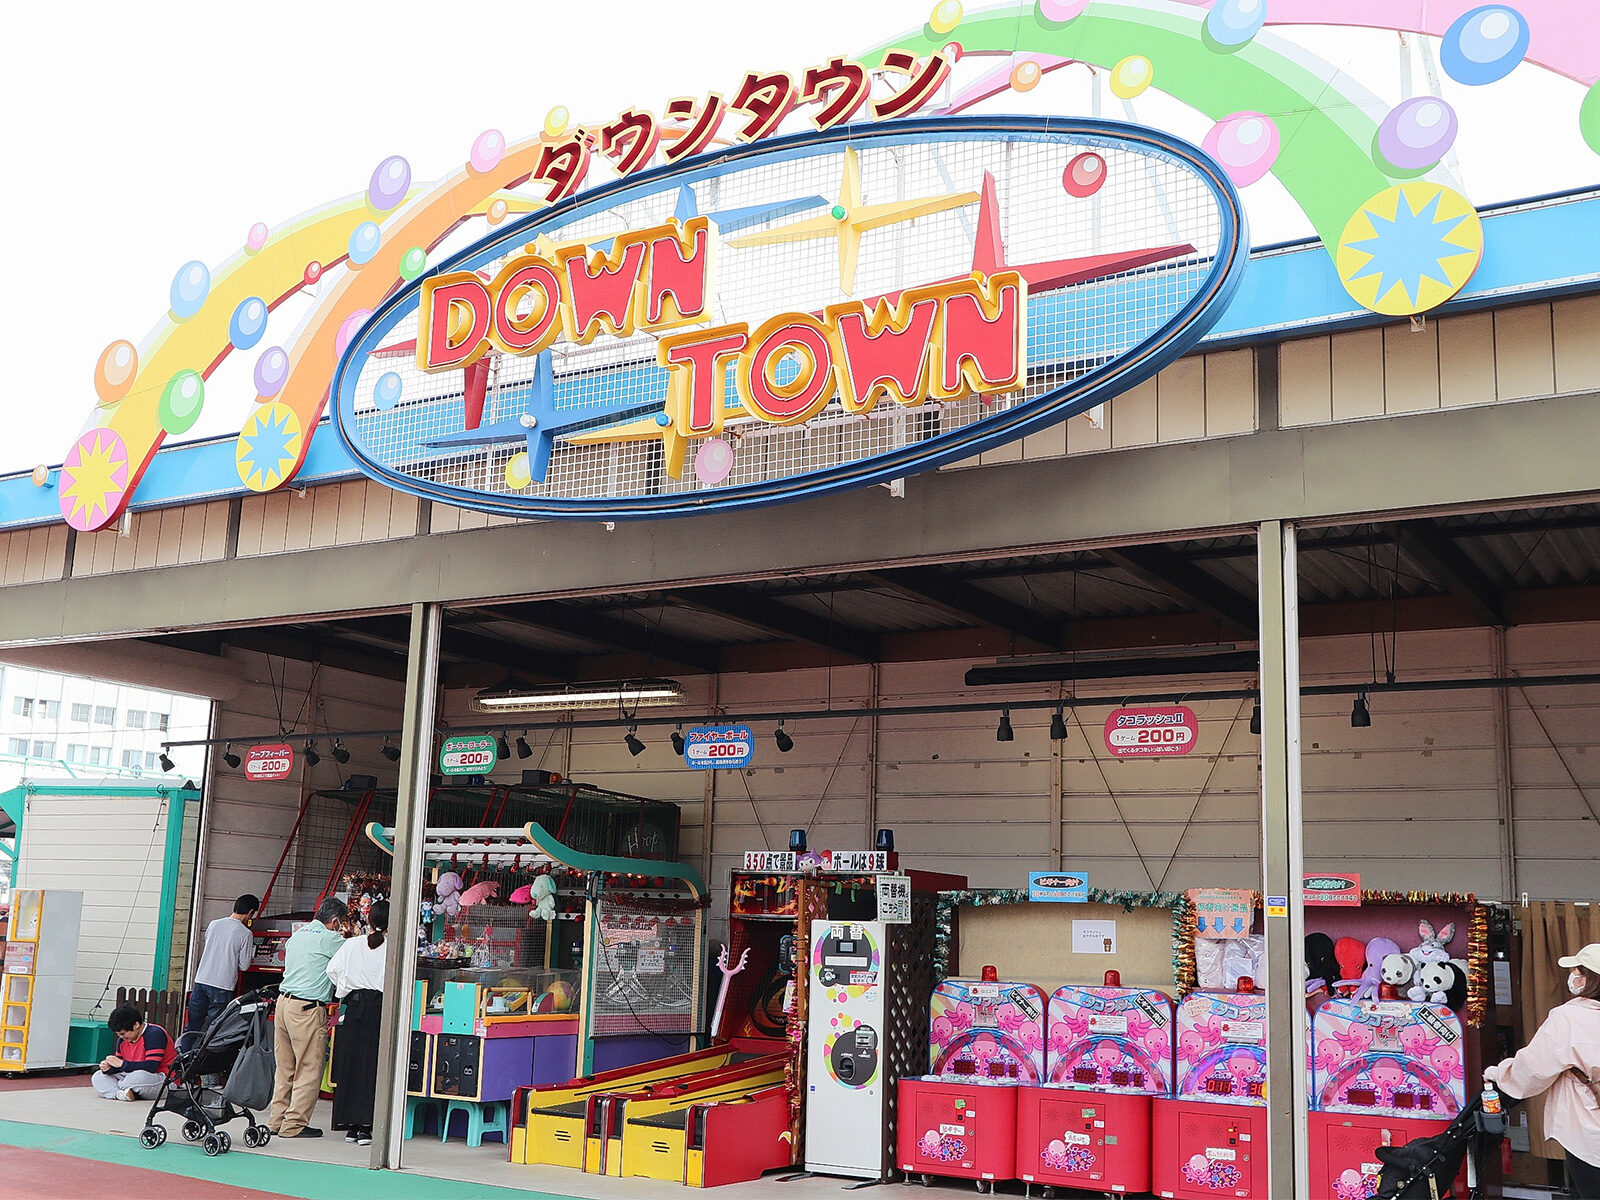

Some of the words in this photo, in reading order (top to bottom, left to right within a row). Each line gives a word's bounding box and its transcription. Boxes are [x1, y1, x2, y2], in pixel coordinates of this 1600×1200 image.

[528, 47, 952, 204] ダウンタウン
[416, 217, 718, 373] DOWN
[657, 270, 1028, 437] TOWN
[689, 729, 749, 742] ファイヤーボール
[1138, 729, 1185, 744] 200円
[459, 752, 489, 765] 200円
[708, 743, 744, 757] 200円
[261, 760, 287, 771] 200円
[746, 852, 794, 870] 350点で景品
[833, 852, 885, 870] ボールは9球
[880, 883, 906, 899] 両替機
[882, 902, 898, 914] こちら
[830, 923, 864, 940] 両替
[1011, 990, 1036, 1018] ビギナー向け
[1137, 996, 1164, 1025] ビギナー向け
[1420, 1010, 1454, 1040] 上級者向け
